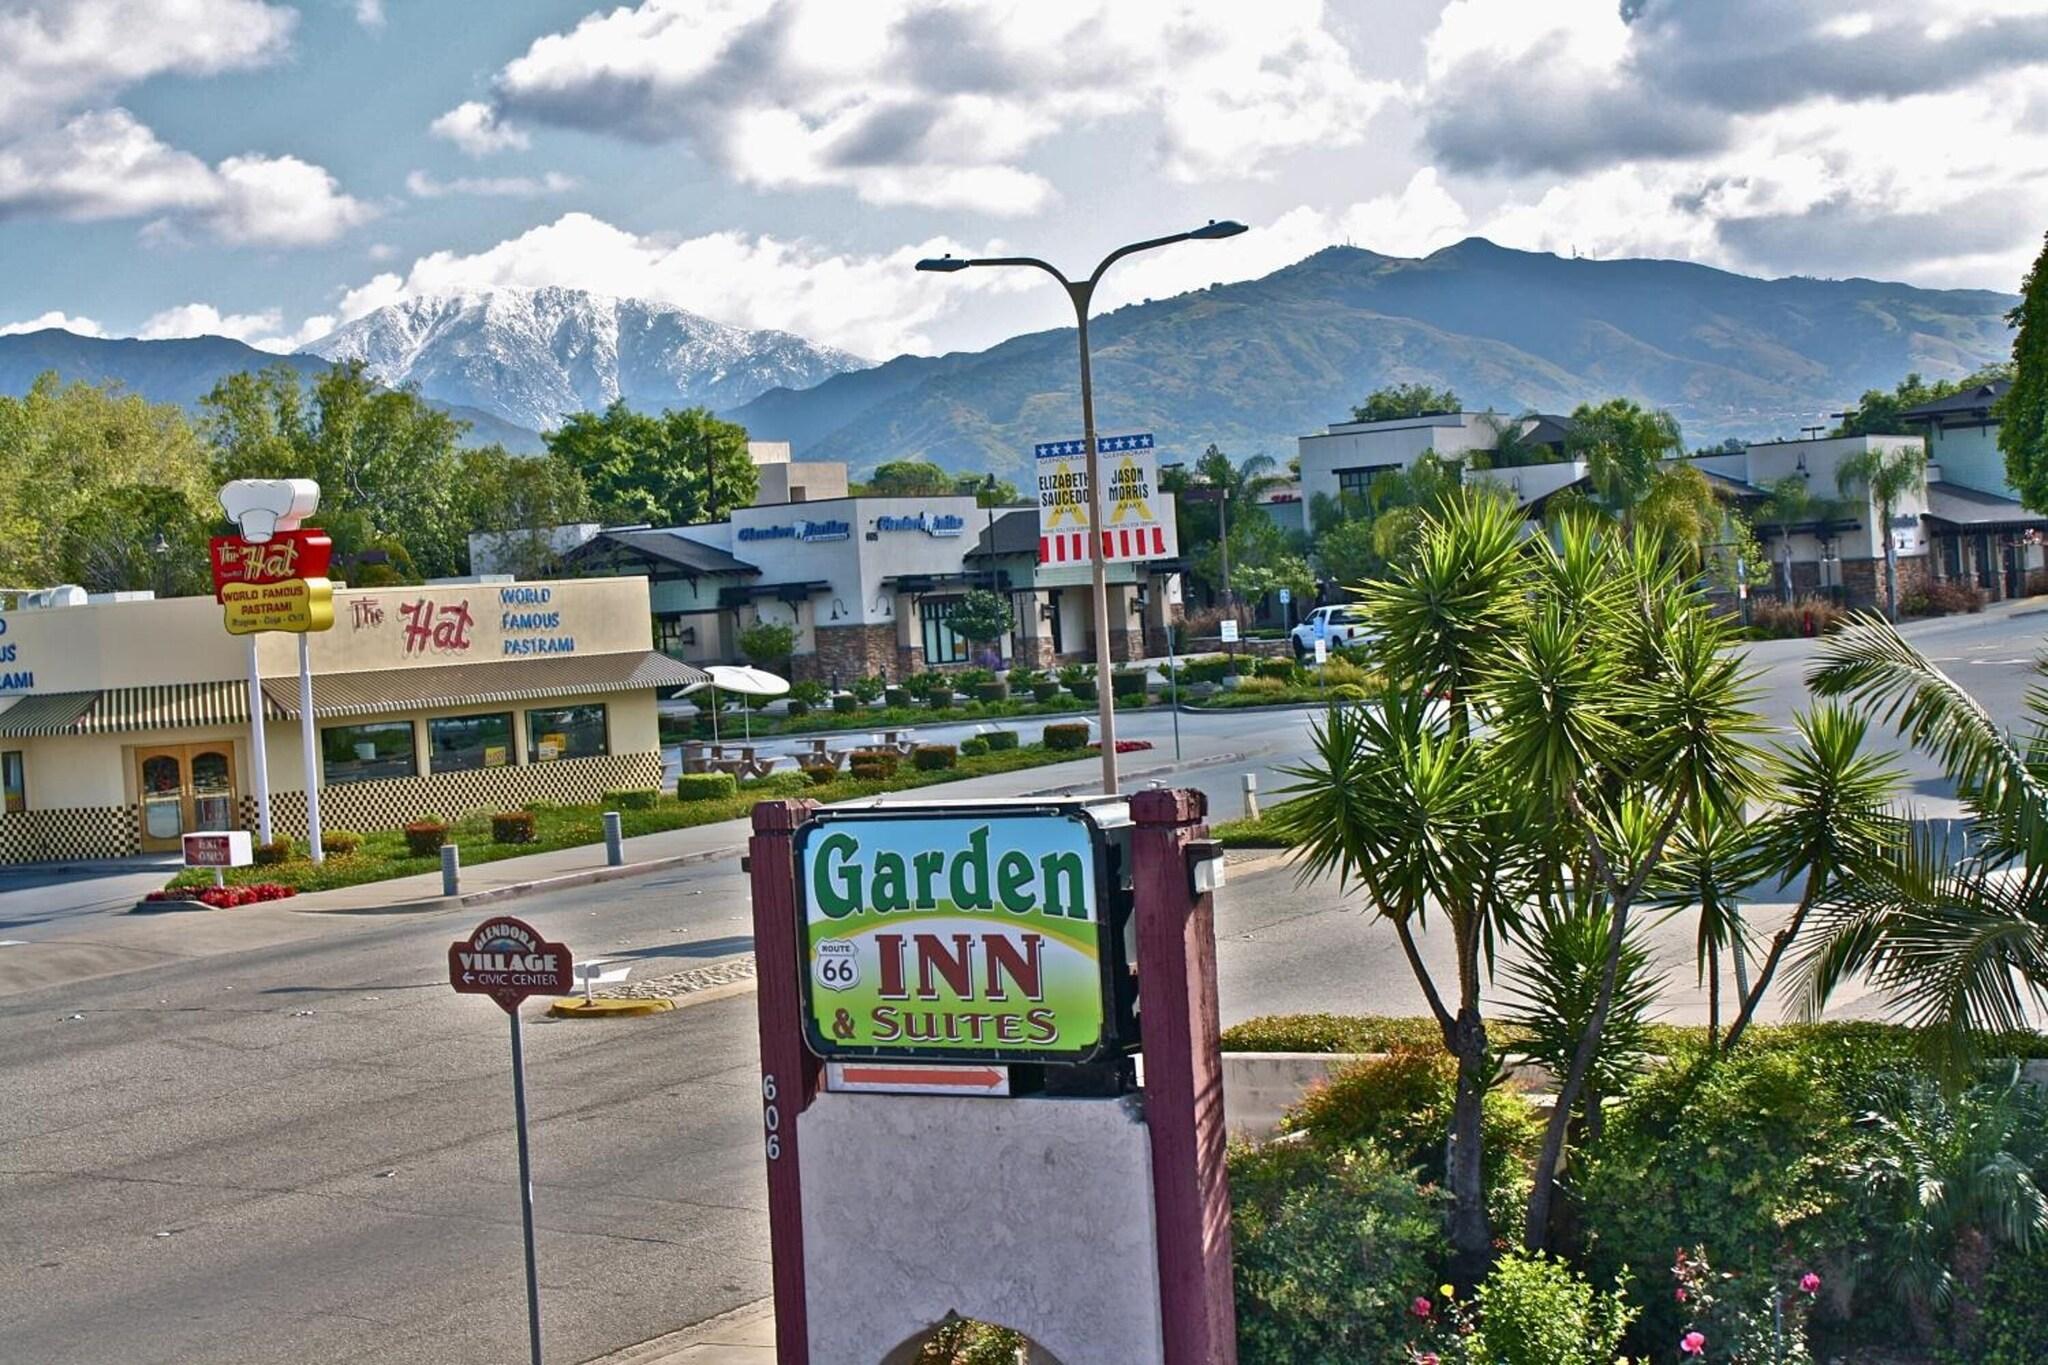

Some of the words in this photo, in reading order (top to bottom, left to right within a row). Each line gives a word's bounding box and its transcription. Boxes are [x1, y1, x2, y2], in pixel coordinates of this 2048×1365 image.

[1111, 467, 1144, 485] JASON
[1041, 488, 1089, 507] SAUCEDO
[1108, 483, 1149, 502] MORRIS
[1054, 506, 1078, 515] ARMY
[1118, 502, 1142, 511] ARMY
[217, 541, 240, 566] The
[240, 538, 299, 580] Hat
[223, 589, 259, 602] WORLD
[262, 586, 304, 599] FAMOUS
[500, 587, 551, 604] WORLD
[241, 601, 292, 615] PASTRAMI
[350, 597, 385, 630] The
[400, 600, 475, 652] Hat
[502, 611, 560, 630] FAMOUS
[504, 637, 575, 654] PASTRAMI
[812, 825, 1090, 921] Garden
[474, 923, 537, 952] GLENDORA
[821, 944, 851, 953] ROUTE
[458, 952, 559, 972] VILLAGE
[823, 959, 853, 982] 66
[874, 933, 1045, 1001] INN
[478, 973, 509, 985] CIVIC
[511, 974, 559, 986] CENTER
[832, 1007, 857, 1040] &
[763, 1074, 780, 1160] 606
